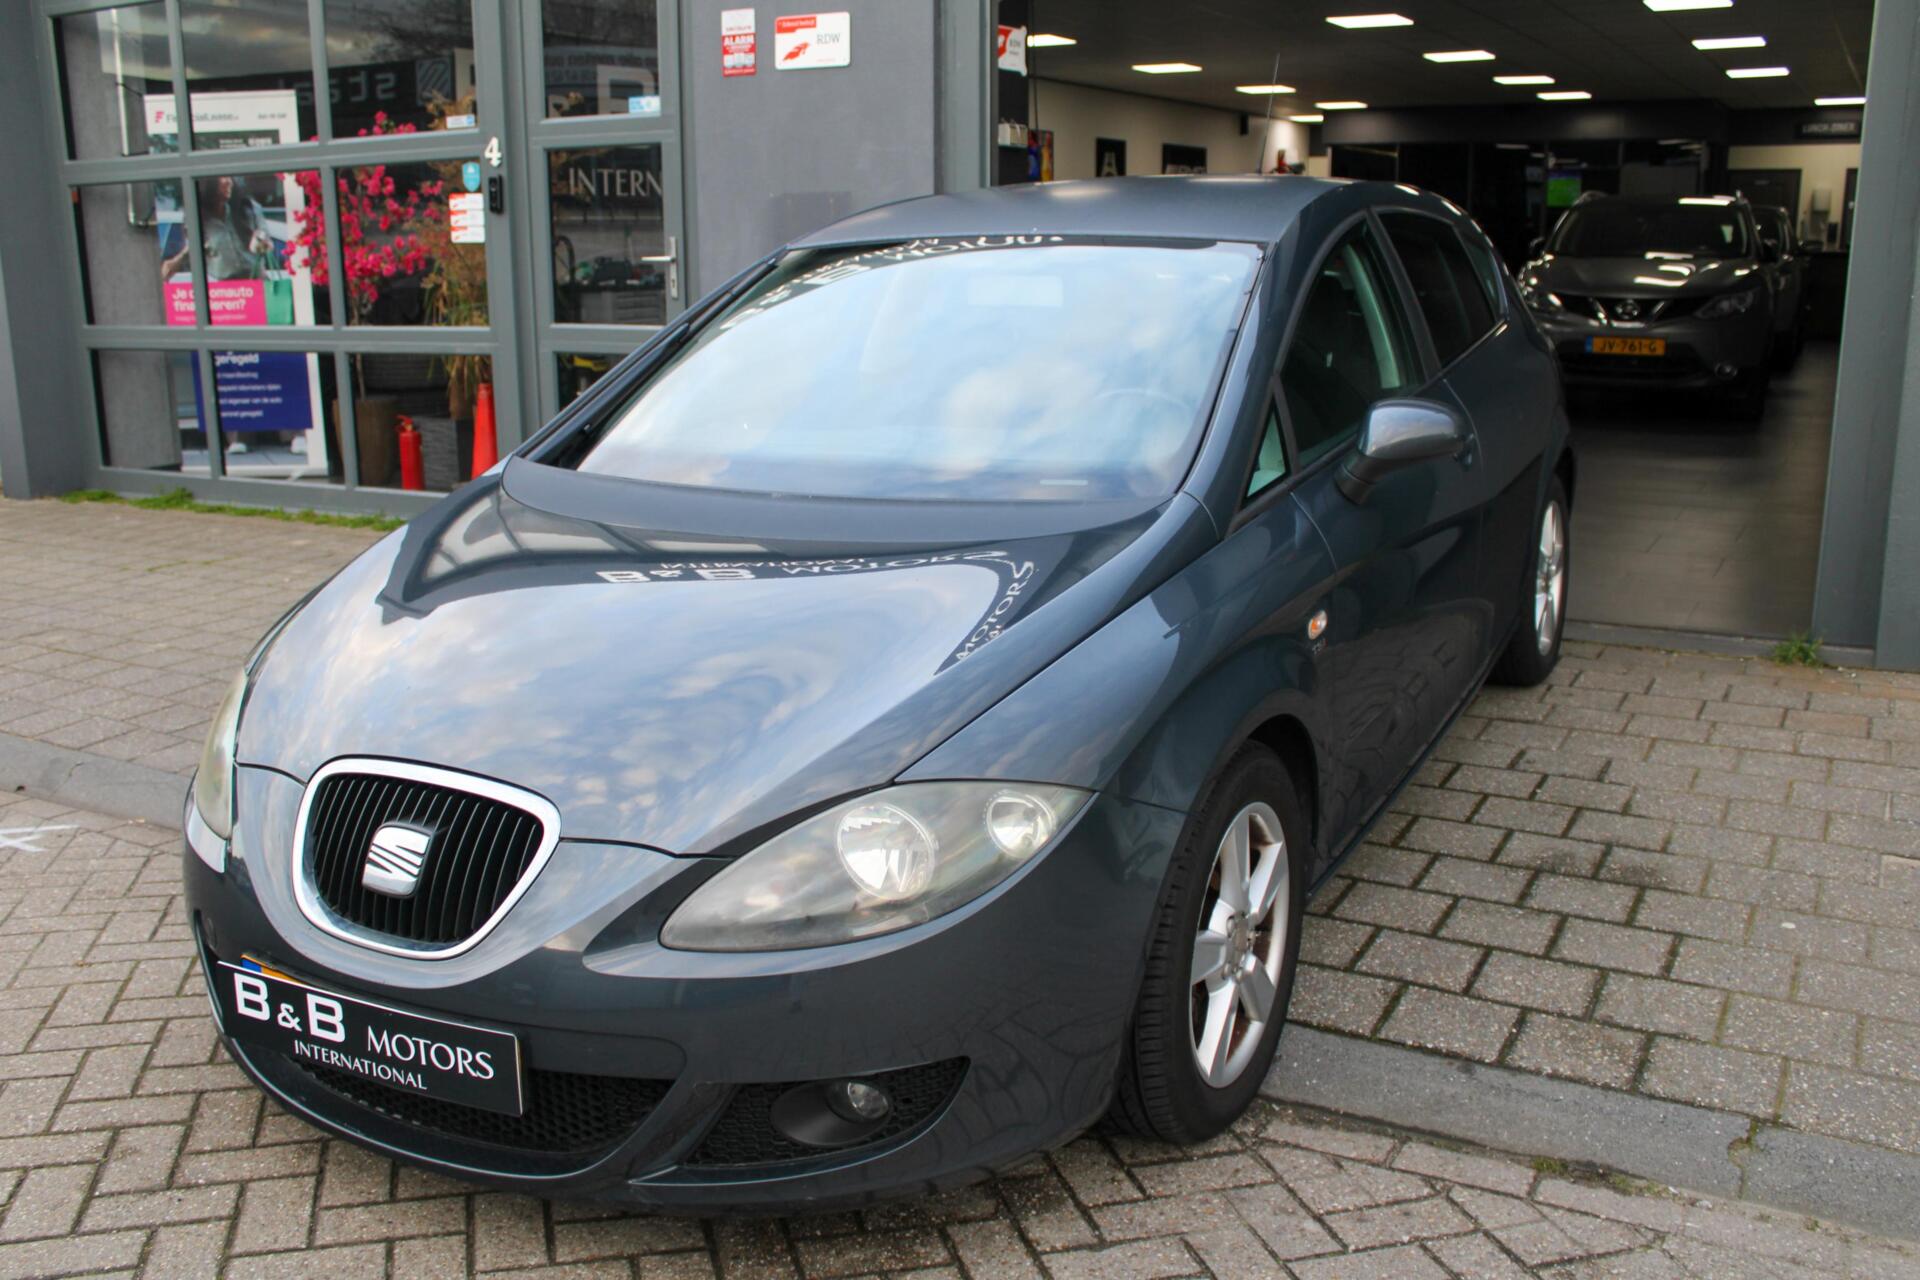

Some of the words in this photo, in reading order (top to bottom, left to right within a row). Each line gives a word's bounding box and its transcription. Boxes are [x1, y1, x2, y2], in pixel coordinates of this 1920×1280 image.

[724, 34, 754, 46] ALARM
[816, 33, 840, 45] RDW
[484, 136, 502, 167] 4
[569, 167, 662, 197] INTERN
[172, 288, 187, 300] Je
[173, 299, 246, 313] finaieren?
[233, 972, 270, 1022] B
[277, 1003, 302, 1031] &
[306, 992, 346, 1042] B
[367, 1025, 495, 1081] MOTORS
[294, 1039, 427, 1091] INTERNATIONAL
